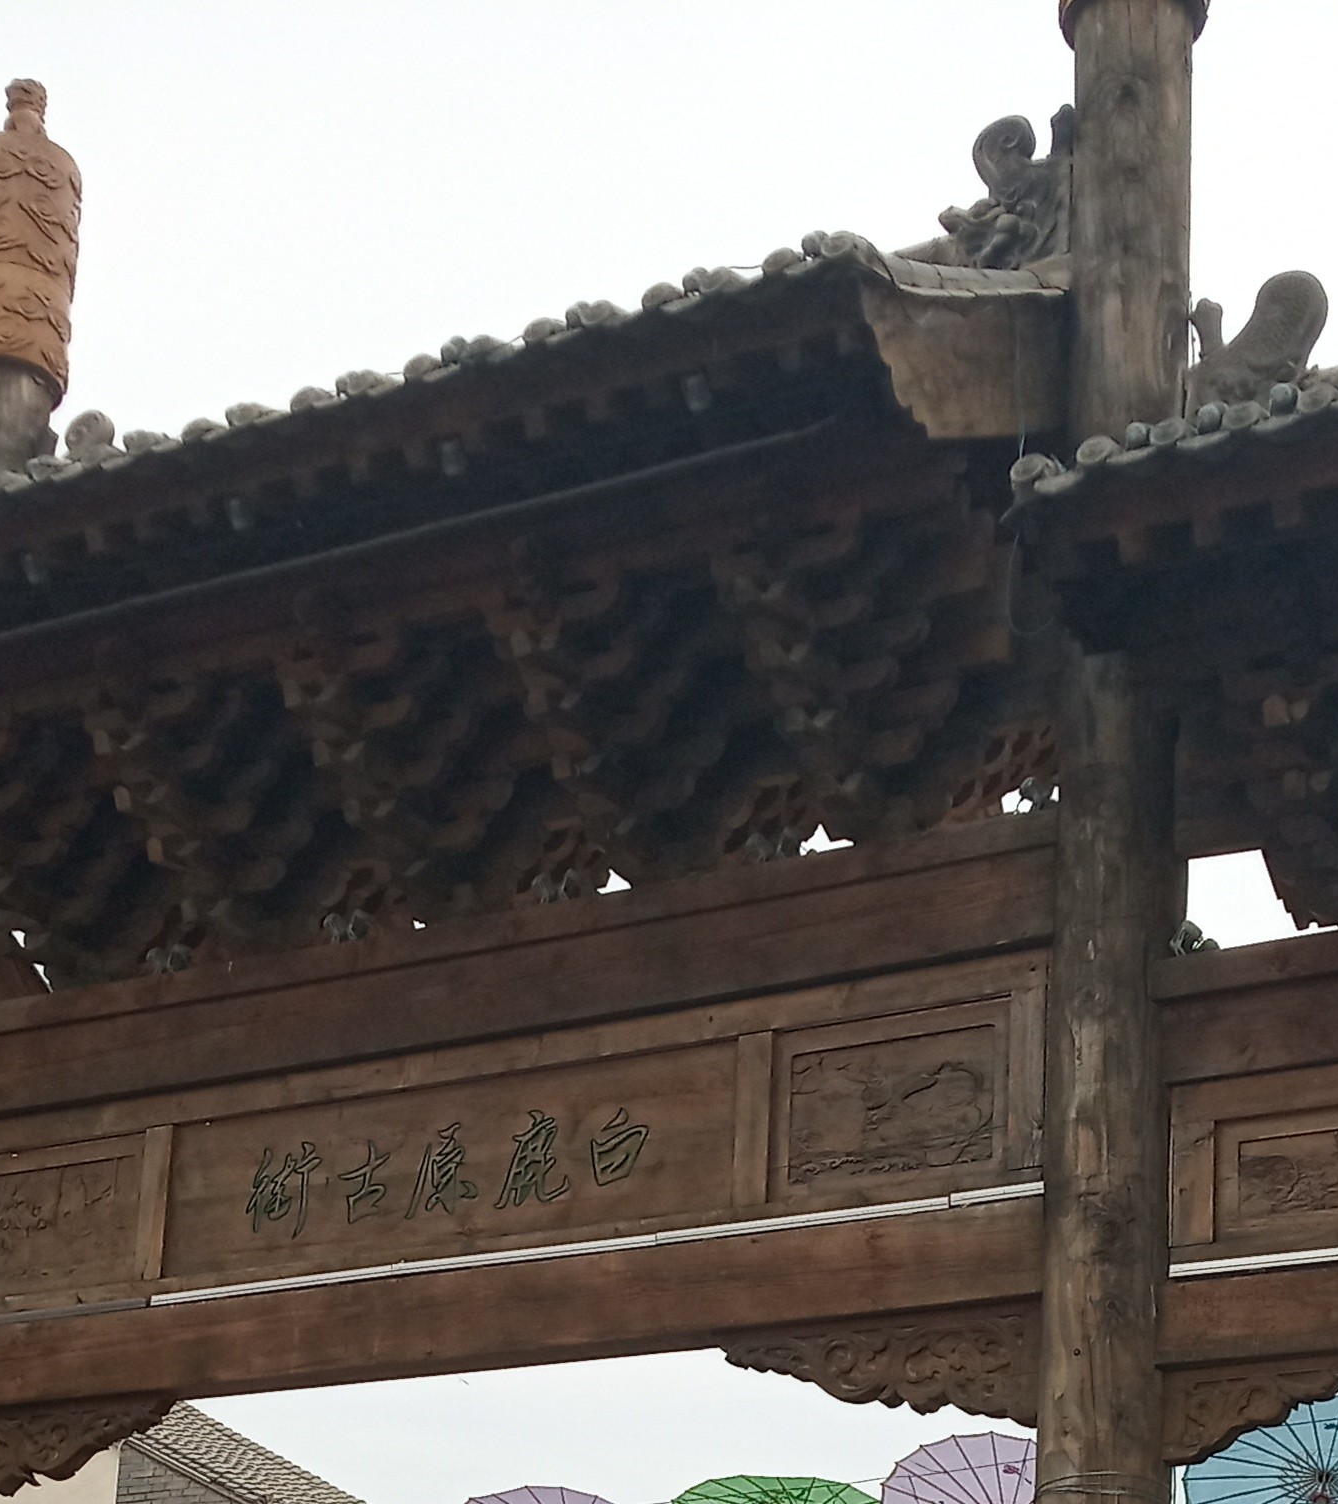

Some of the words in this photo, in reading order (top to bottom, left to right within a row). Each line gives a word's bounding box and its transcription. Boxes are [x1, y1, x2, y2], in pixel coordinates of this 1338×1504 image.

[245, 1107, 649, 1240] 白鹿原古街
